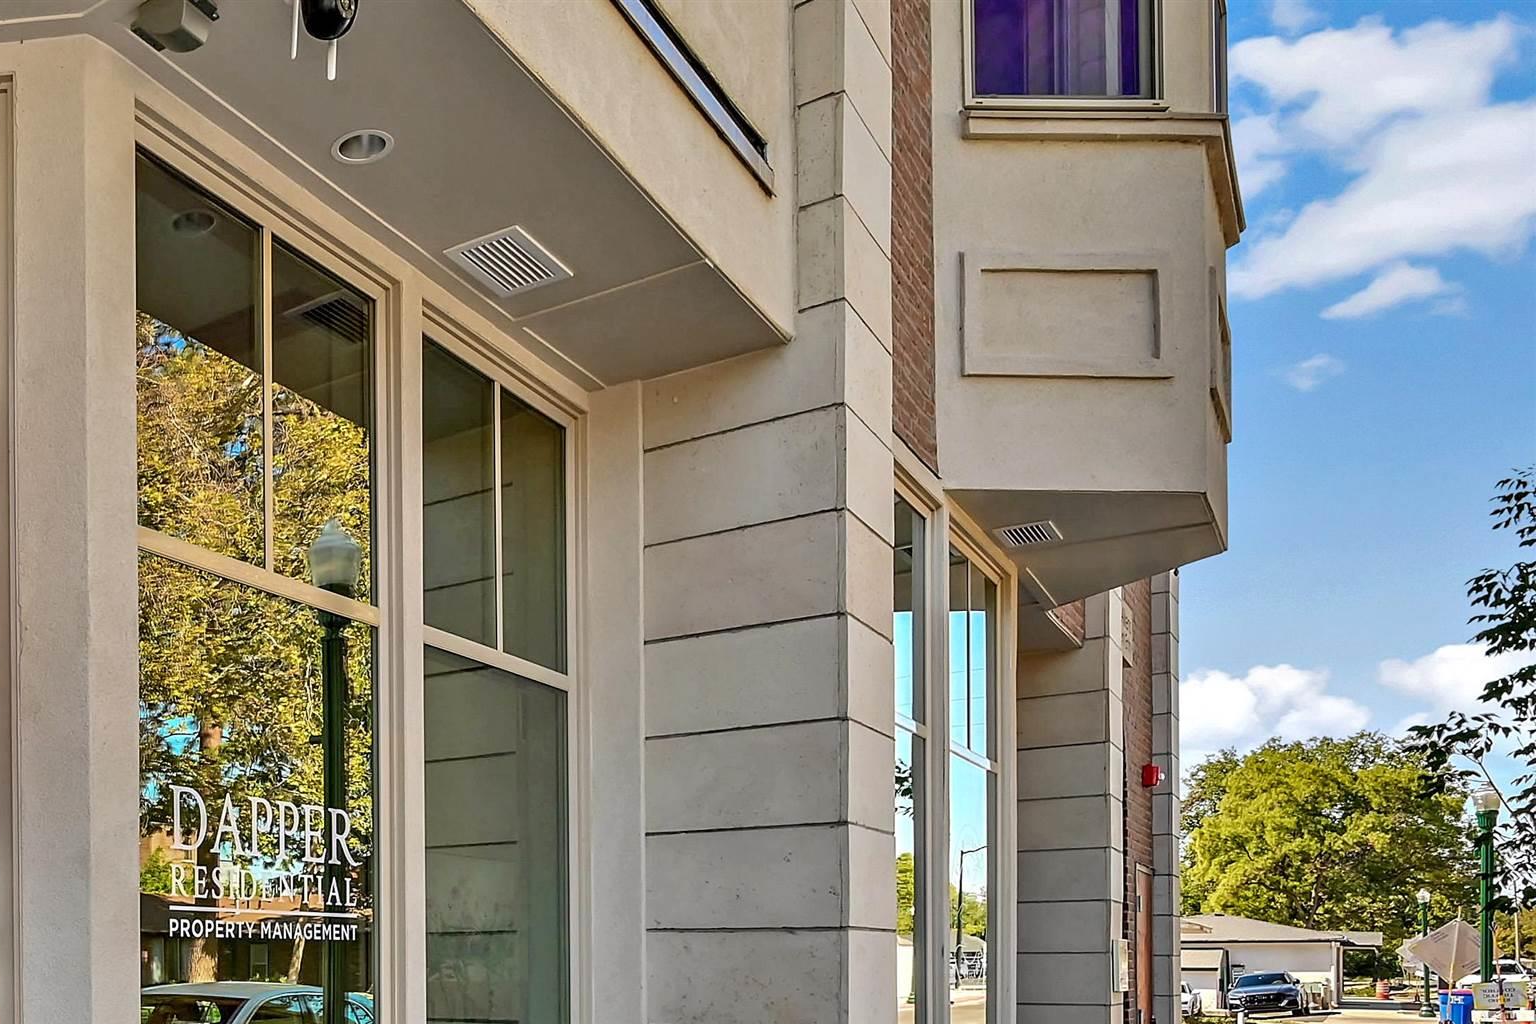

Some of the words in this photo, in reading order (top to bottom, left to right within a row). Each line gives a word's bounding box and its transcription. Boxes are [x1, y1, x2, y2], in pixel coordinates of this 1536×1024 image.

[169, 785, 363, 867] DAPPER
[169, 864, 358, 907] RESIDENTIAL
[168, 918, 255, 940] PROPERTY
[260, 922, 358, 941] MANAGEMENT
